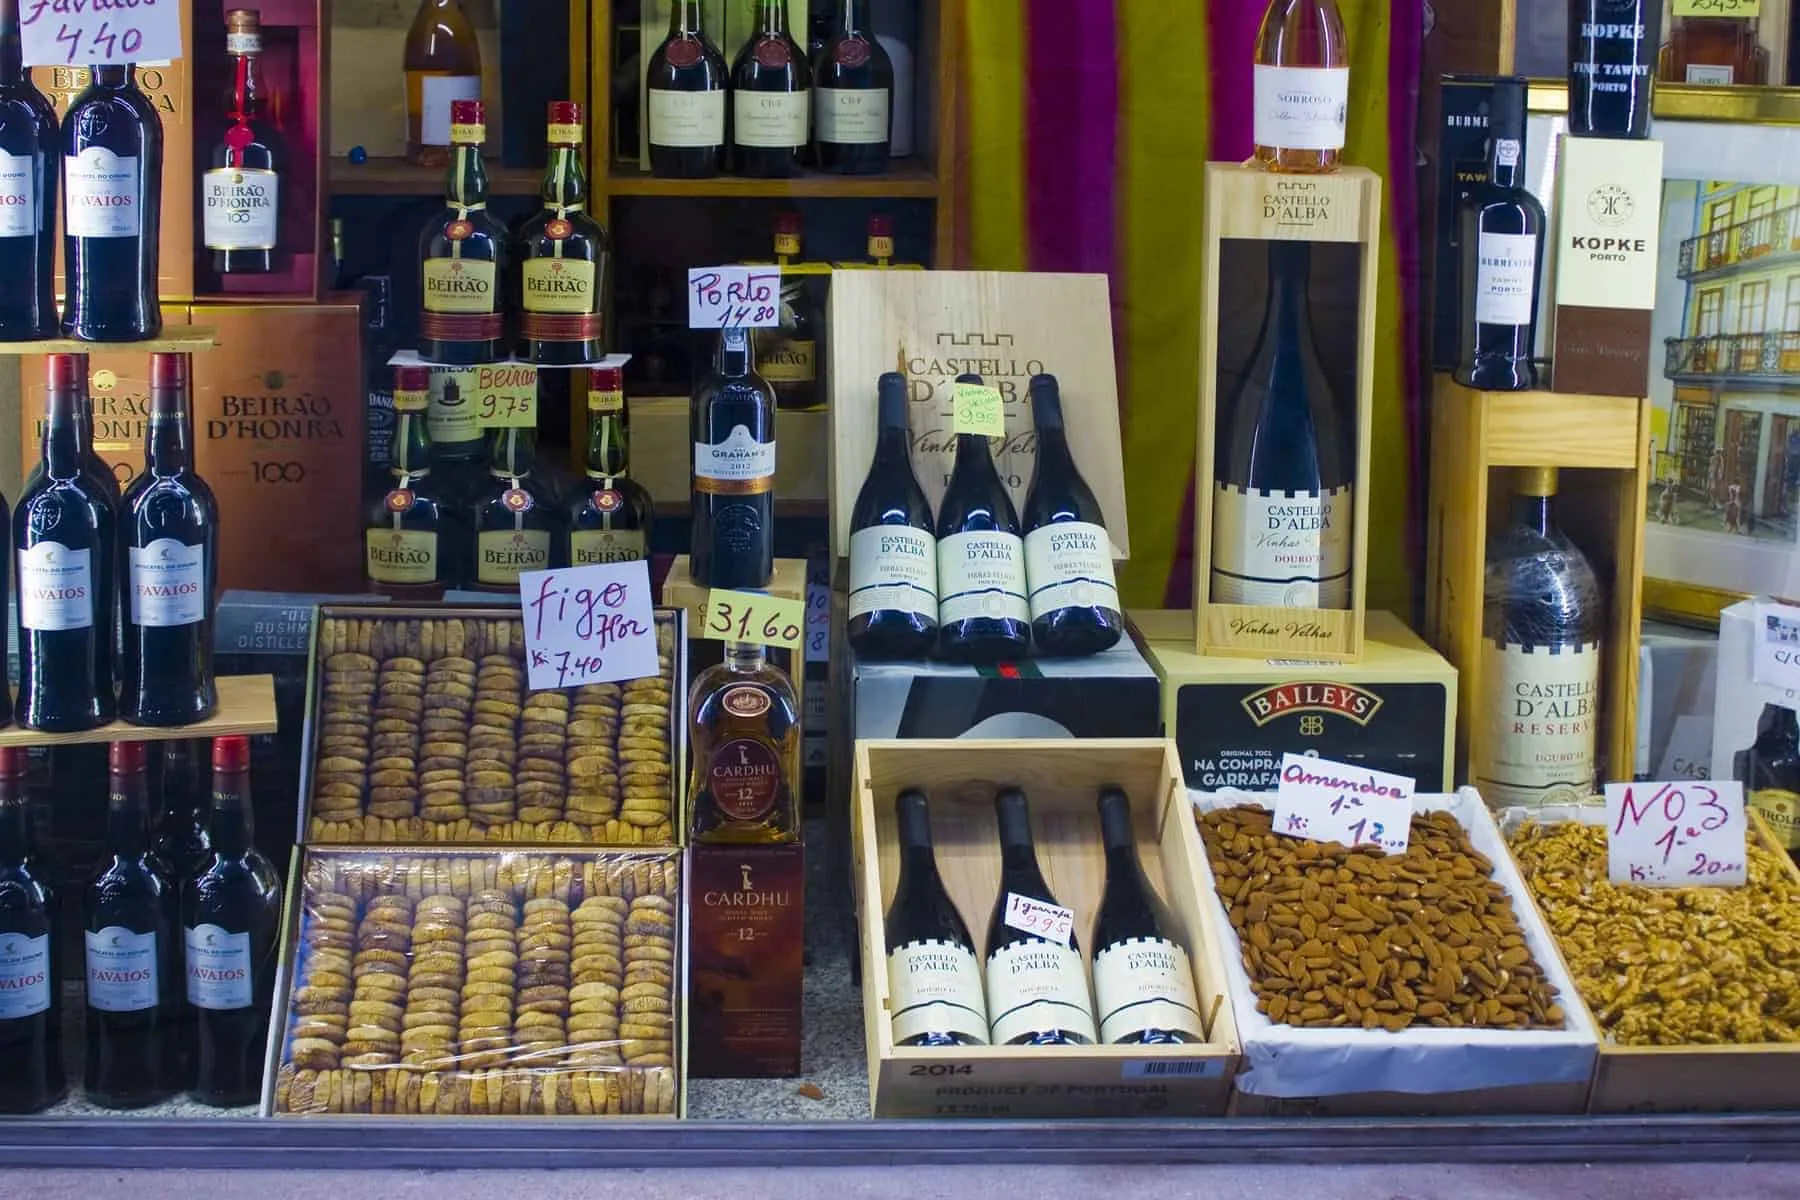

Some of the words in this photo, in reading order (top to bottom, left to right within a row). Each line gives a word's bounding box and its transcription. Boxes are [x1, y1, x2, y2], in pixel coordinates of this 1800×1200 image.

[56, 22, 143, 63] 4.40
[1263, 194, 1330, 206] CASTELLO
[1572, 236, 1645, 252] KOPKE
[1590, 253, 1626, 262] PORTO
[428, 277, 489, 293] BEIRÃO
[527, 277, 588, 293] BEIRÃO
[221, 393, 331, 417] BEIRÃO
[480, 394, 532, 419] 9.75
[208, 421, 344, 440] D'HONRA
[252, 461, 305, 483] 100
[1268, 505, 1332, 517] CASTELLO
[370, 547, 430, 565] BEIRÃO
[485, 548, 546, 565] BEIRÃO
[136, 582, 198, 597] FAVAIOS
[710, 603, 799, 641] 31.60
[1230, 618, 1280, 636] Vinhas
[1285, 622, 1332, 640] Velhas
[555, 652, 602, 688] 7.40
[1254, 685, 1370, 716] BAILEYS
[1514, 722, 1592, 736] RESERV
[713, 764, 775, 777] CARDHU
[1194, 759, 1215, 771] NA
[1219, 759, 1282, 770] COMPRA
[737, 788, 753, 800] 12
[704, 891, 789, 906] CARDHU
[738, 927, 755, 941] 12
[90, 968, 150, 983] FAVAIOS
[907, 1063, 975, 1077] 2014
